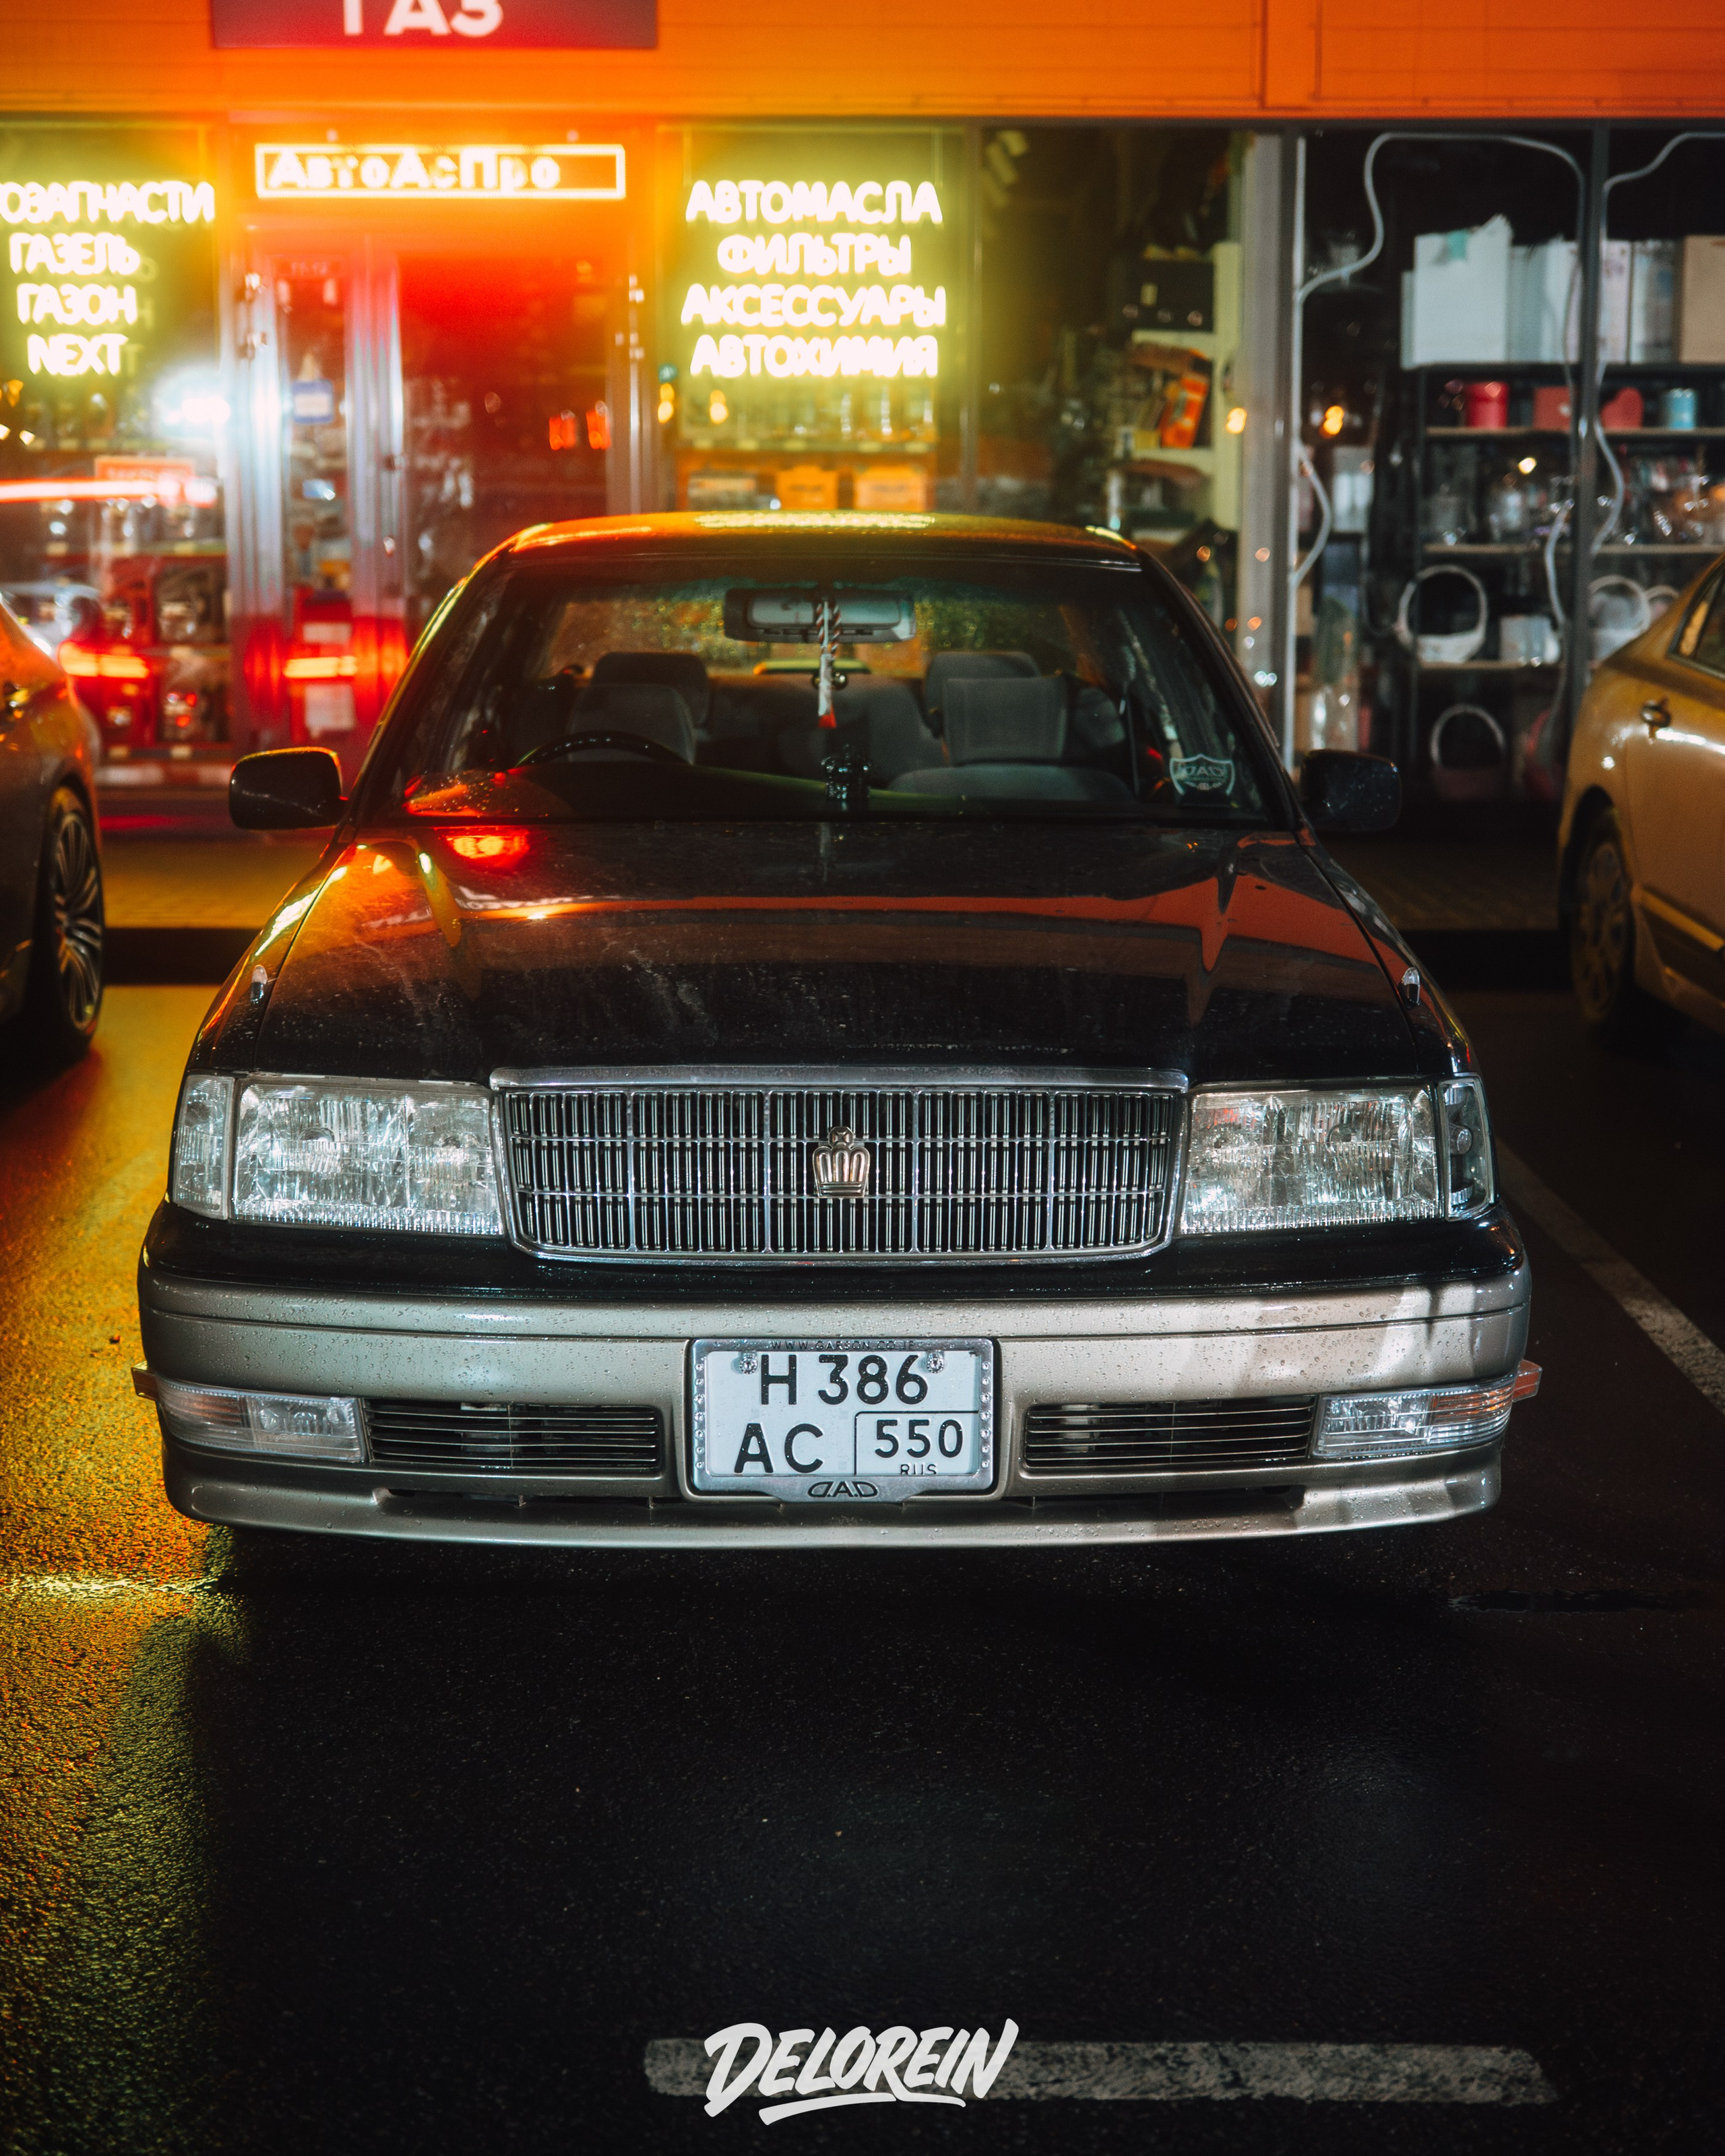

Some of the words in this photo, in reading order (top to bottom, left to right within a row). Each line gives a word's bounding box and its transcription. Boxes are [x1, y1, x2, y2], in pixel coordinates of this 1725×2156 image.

[685, 180, 943, 224] АВТОМАСЛА
[9, 232, 140, 275] ГАЗЕЛЬ
[717, 232, 912, 276] ФИЛЬТРЫ
[17, 283, 137, 325] ГАЗОН
[681, 283, 946, 327] АКСЕССУАРЫ
[27, 334, 129, 376] NEXT
[690, 334, 939, 378] АВТОХИМИЯ
[817, 1354, 928, 1405] 386
[875, 1419, 963, 1459] 550
[900, 1463, 937, 1475] RUS
